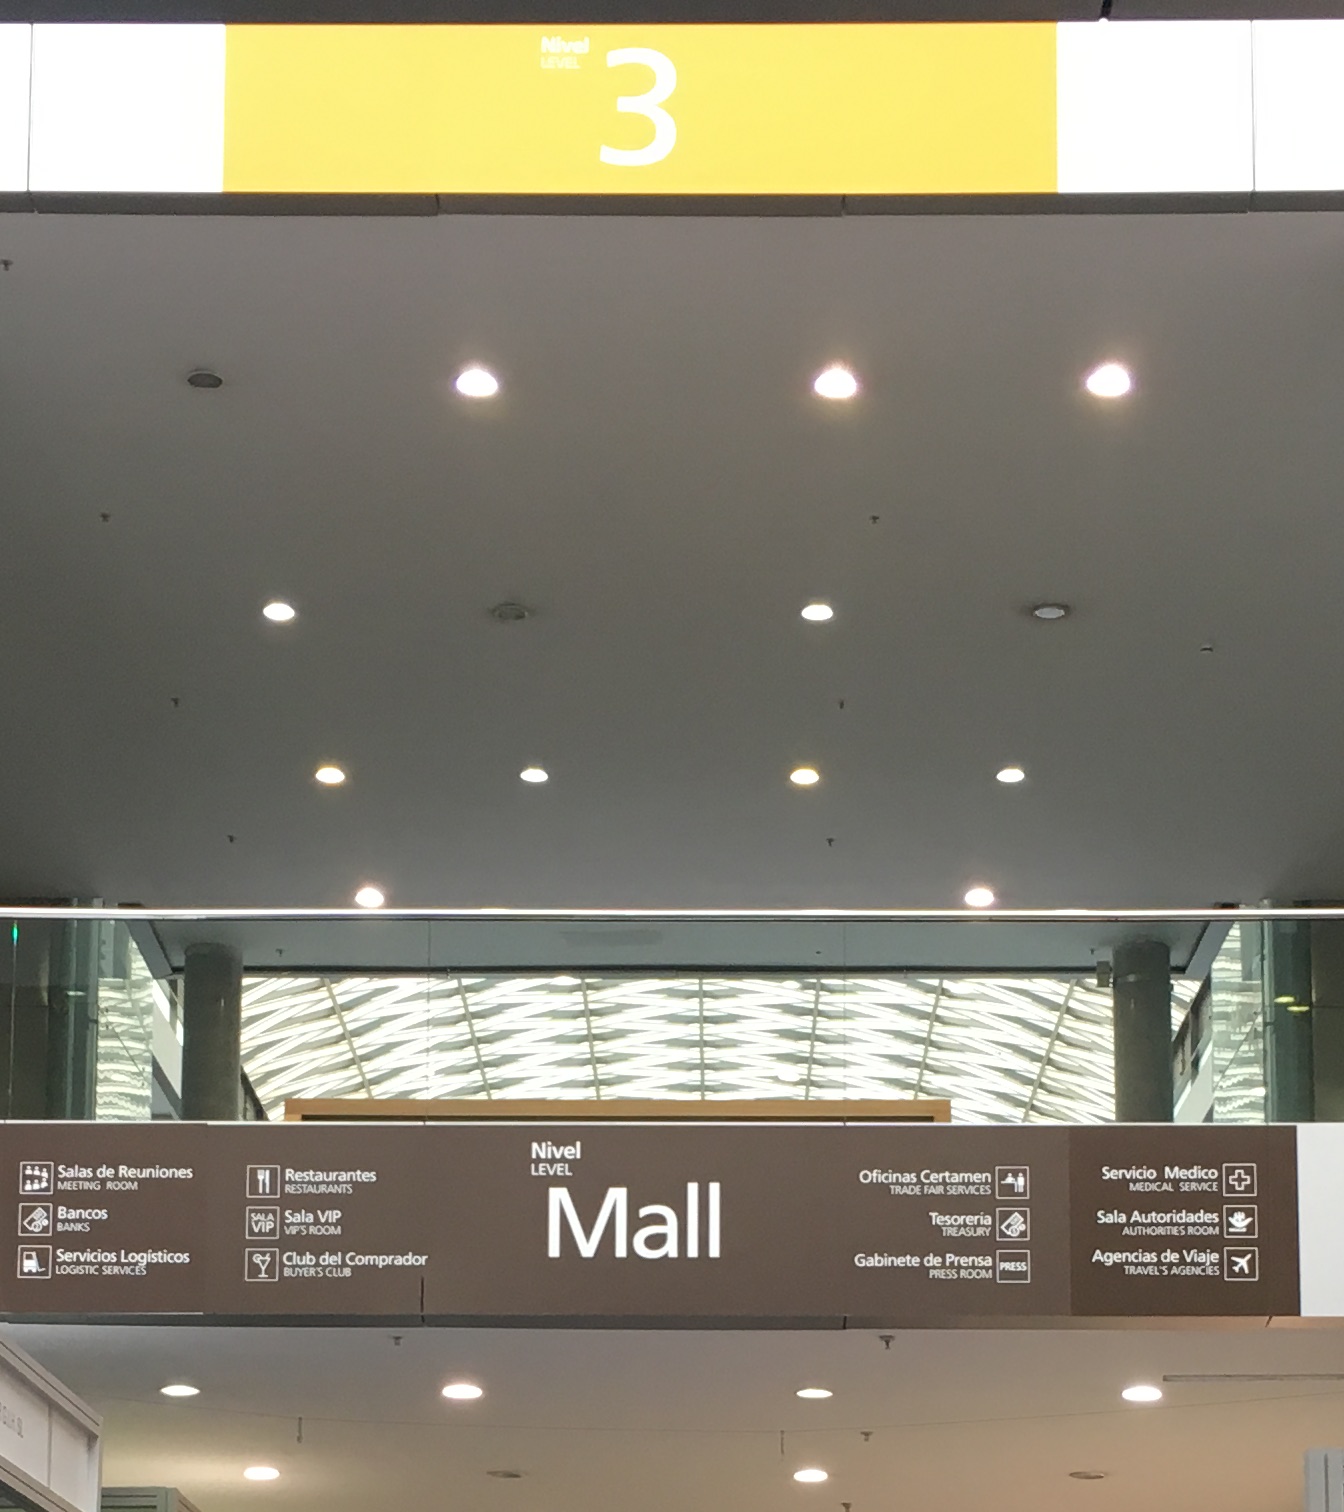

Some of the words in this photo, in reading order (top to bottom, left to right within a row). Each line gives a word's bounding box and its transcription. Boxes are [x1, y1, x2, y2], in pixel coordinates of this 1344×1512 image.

[541, 36, 590, 54] Nivel
[599, 47, 677, 166] 3
[531, 1141, 581, 1159] Nivel
[57, 1164, 93, 1179] Salas
[96, 1164, 115, 1178] de
[118, 1165, 194, 1179] Reuniones
[285, 1168, 377, 1182] Restaurantes
[530, 1163, 573, 1176] LEVEL
[1102, 1165, 1157, 1180] Servicio
[1164, 1166, 1219, 1180] Medico
[859, 1169, 917, 1184] Oficinas
[920, 1170, 992, 1184] Certamen
[57, 1180, 101, 1191] MEETING
[106, 1181, 138, 1191] ROOM
[284, 1183, 353, 1195] RESTAURANTS
[889, 1184, 922, 1195] TRADE
[924, 1184, 945, 1195] FAIR
[946, 1184, 992, 1195] SERVICES
[1128, 1181, 1174, 1192] MEDICAL
[1178, 1181, 1219, 1192] SERVICE
[57, 1205, 108, 1220] Bancos
[250, 1212, 275, 1222] SALA
[284, 1209, 314, 1224] Sala
[317, 1210, 342, 1223] VIP
[1096, 1209, 1127, 1224] Sala
[1130, 1209, 1220, 1224] Autoridades
[56, 1221, 91, 1232] BANKS
[548, 1181, 721, 1259] Mall
[251, 1221, 275, 1233] VIP
[308, 1225, 341, 1235] ROOM
[941, 1226, 992, 1237] TREASURY
[1122, 1225, 1186, 1236] AUTHORITIES
[1187, 1225, 1220, 1236] ROOM
[56, 1248, 117, 1263] Servicios
[120, 1249, 191, 1266] Logísticos
[282, 1251, 316, 1266] Club
[319, 1251, 342, 1266] del
[345, 1251, 428, 1269] Comprador
[854, 1253, 921, 1267] Gabinete
[923, 1253, 943, 1267] de
[945, 1254, 993, 1267] Prensa
[1092, 1249, 1158, 1266] Agencias
[1161, 1249, 1180, 1263] de
[1183, 1249, 1220, 1266] Viaje
[55, 1265, 99, 1275] LOGISTIC
[101, 1265, 147, 1276] SERVICES
[325, 1267, 352, 1278] CLUB
[999, 1261, 1027, 1271] PRESS
[1170, 1265, 1220, 1276] AGENCIES
[928, 1268, 958, 1279] PRESS
[960, 1269, 993, 1279] ROOM
